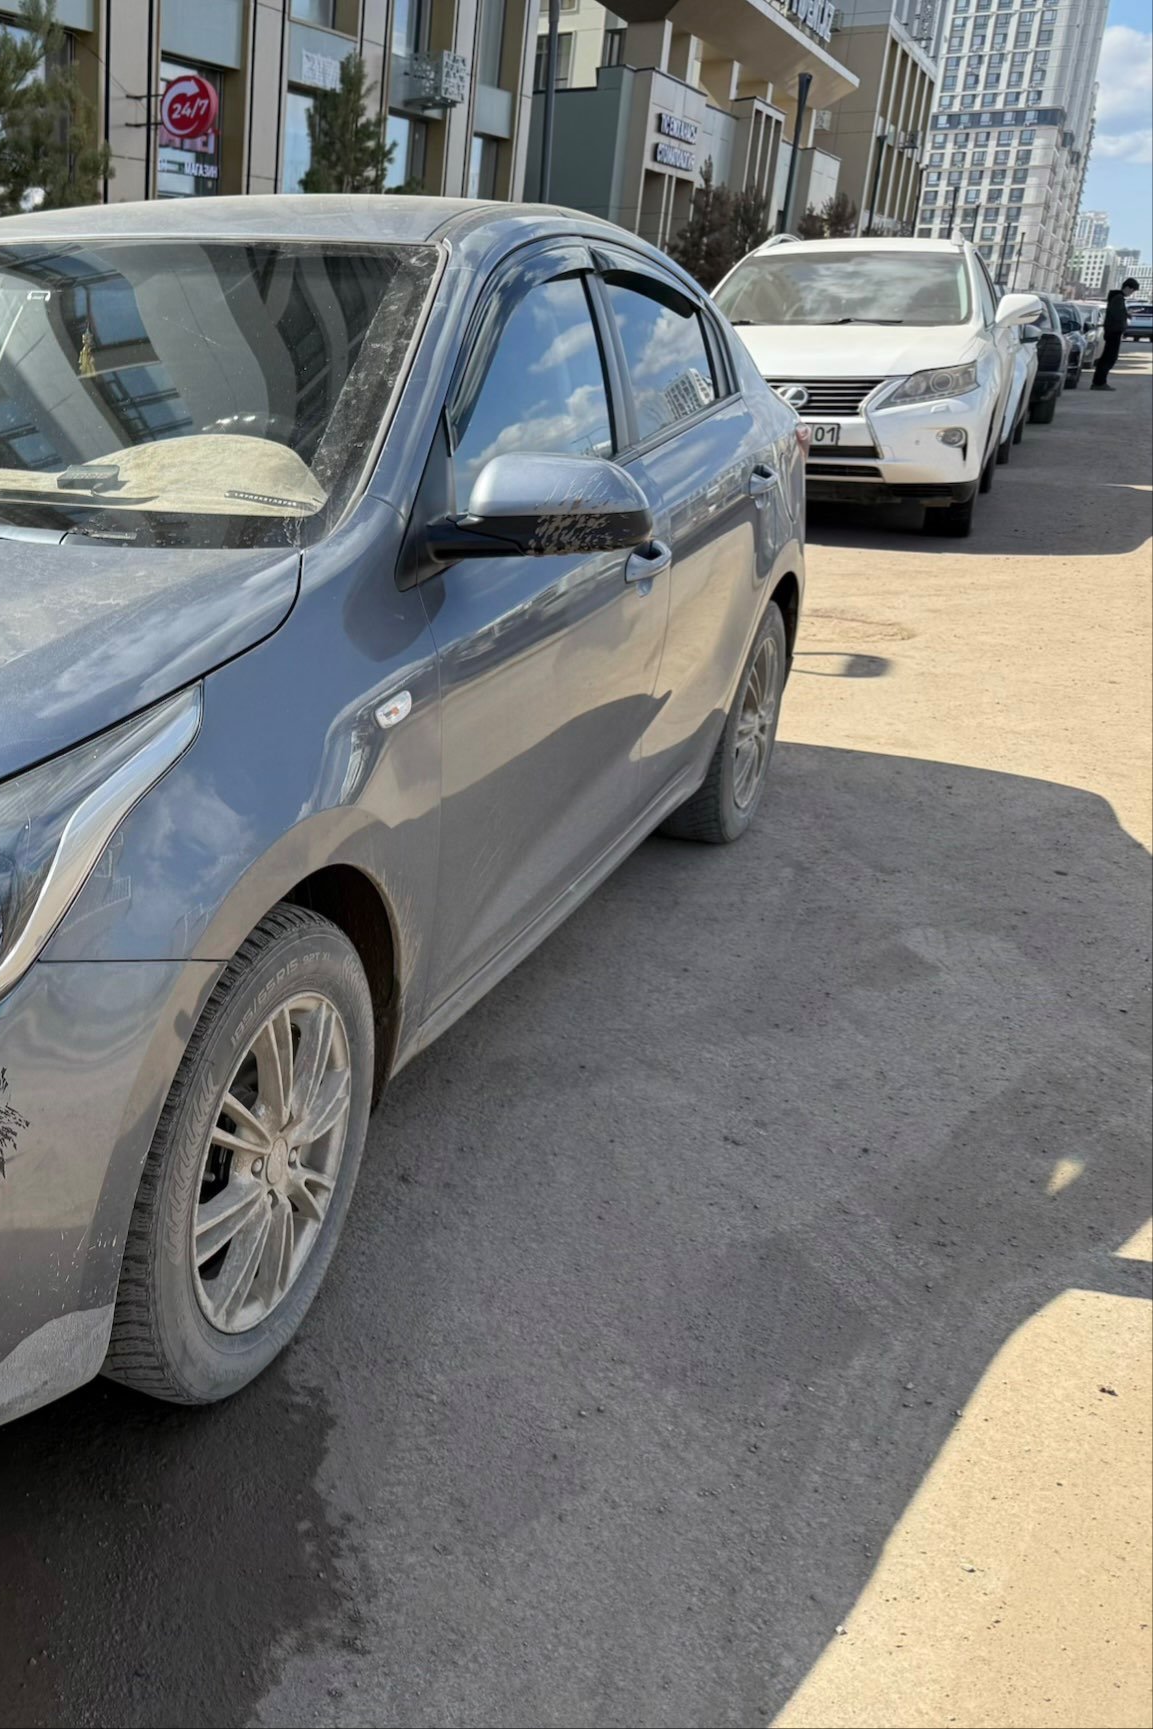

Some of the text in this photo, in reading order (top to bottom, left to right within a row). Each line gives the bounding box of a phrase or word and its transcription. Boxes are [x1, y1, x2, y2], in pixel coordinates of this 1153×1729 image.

[172, 98, 209, 119] 24/7
[184, 161, 218, 178] МАГАЗИН
[815, 426, 836, 442] 01
